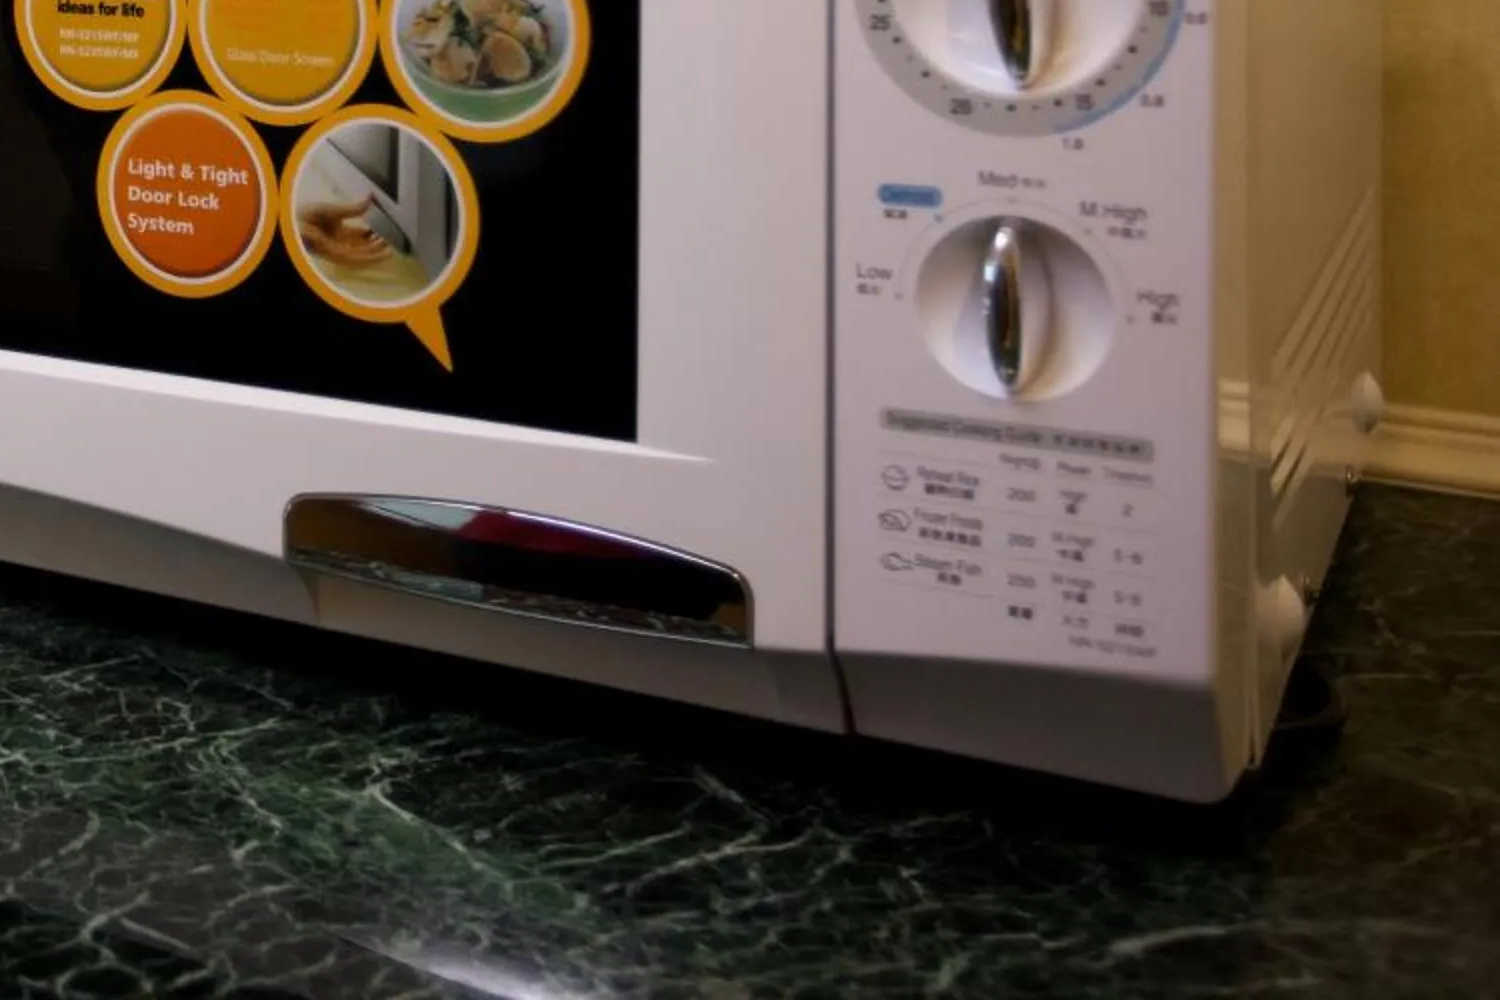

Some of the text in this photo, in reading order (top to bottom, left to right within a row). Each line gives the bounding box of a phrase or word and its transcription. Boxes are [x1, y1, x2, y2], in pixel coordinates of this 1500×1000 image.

[58, 0, 145, 18] ideas for life
[227, 47, 257, 61] Glass
[128, 158, 249, 187] Light & Tight
[128, 185, 219, 210] Door Lock
[128, 212, 194, 234] System
[856, 264, 892, 280] Low
